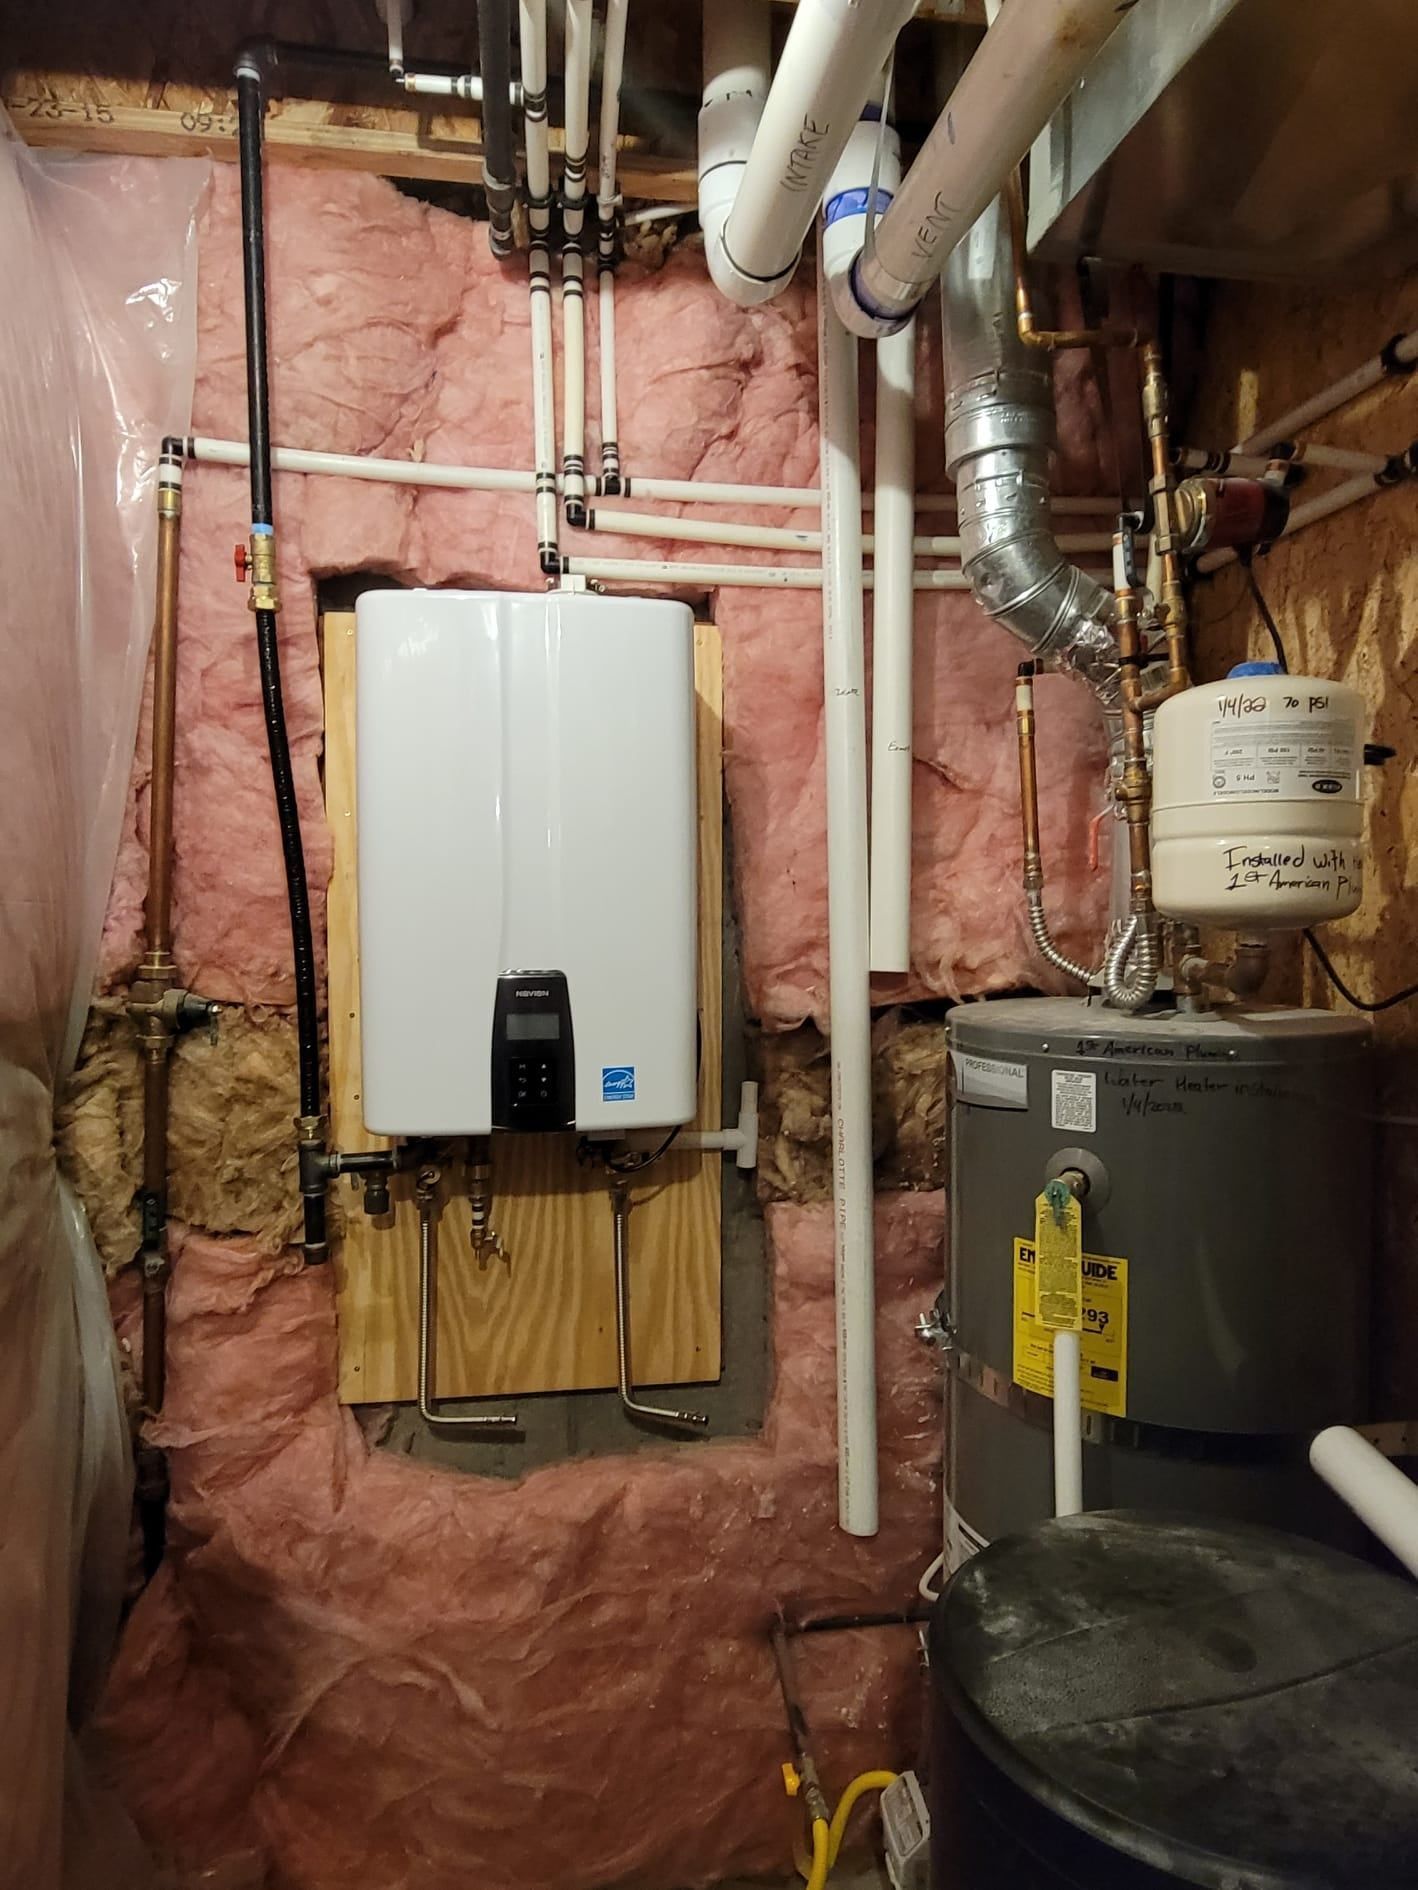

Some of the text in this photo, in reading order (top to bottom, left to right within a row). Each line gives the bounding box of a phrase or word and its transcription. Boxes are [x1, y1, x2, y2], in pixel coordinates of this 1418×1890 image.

[779, 113, 830, 193] INTAKE
[911, 190, 961, 259] VENT
[1282, 696, 1300, 709] 70
[1223, 844, 1305, 871] Installed
[1268, 869, 1330, 891] American
[1103, 1041, 1174, 1057] American
[965, 1058, 1025, 1079] PROFESSIONAL
[838, 1118, 846, 1190] CHARLOTTE
[839, 1198, 847, 1231] PIPE
